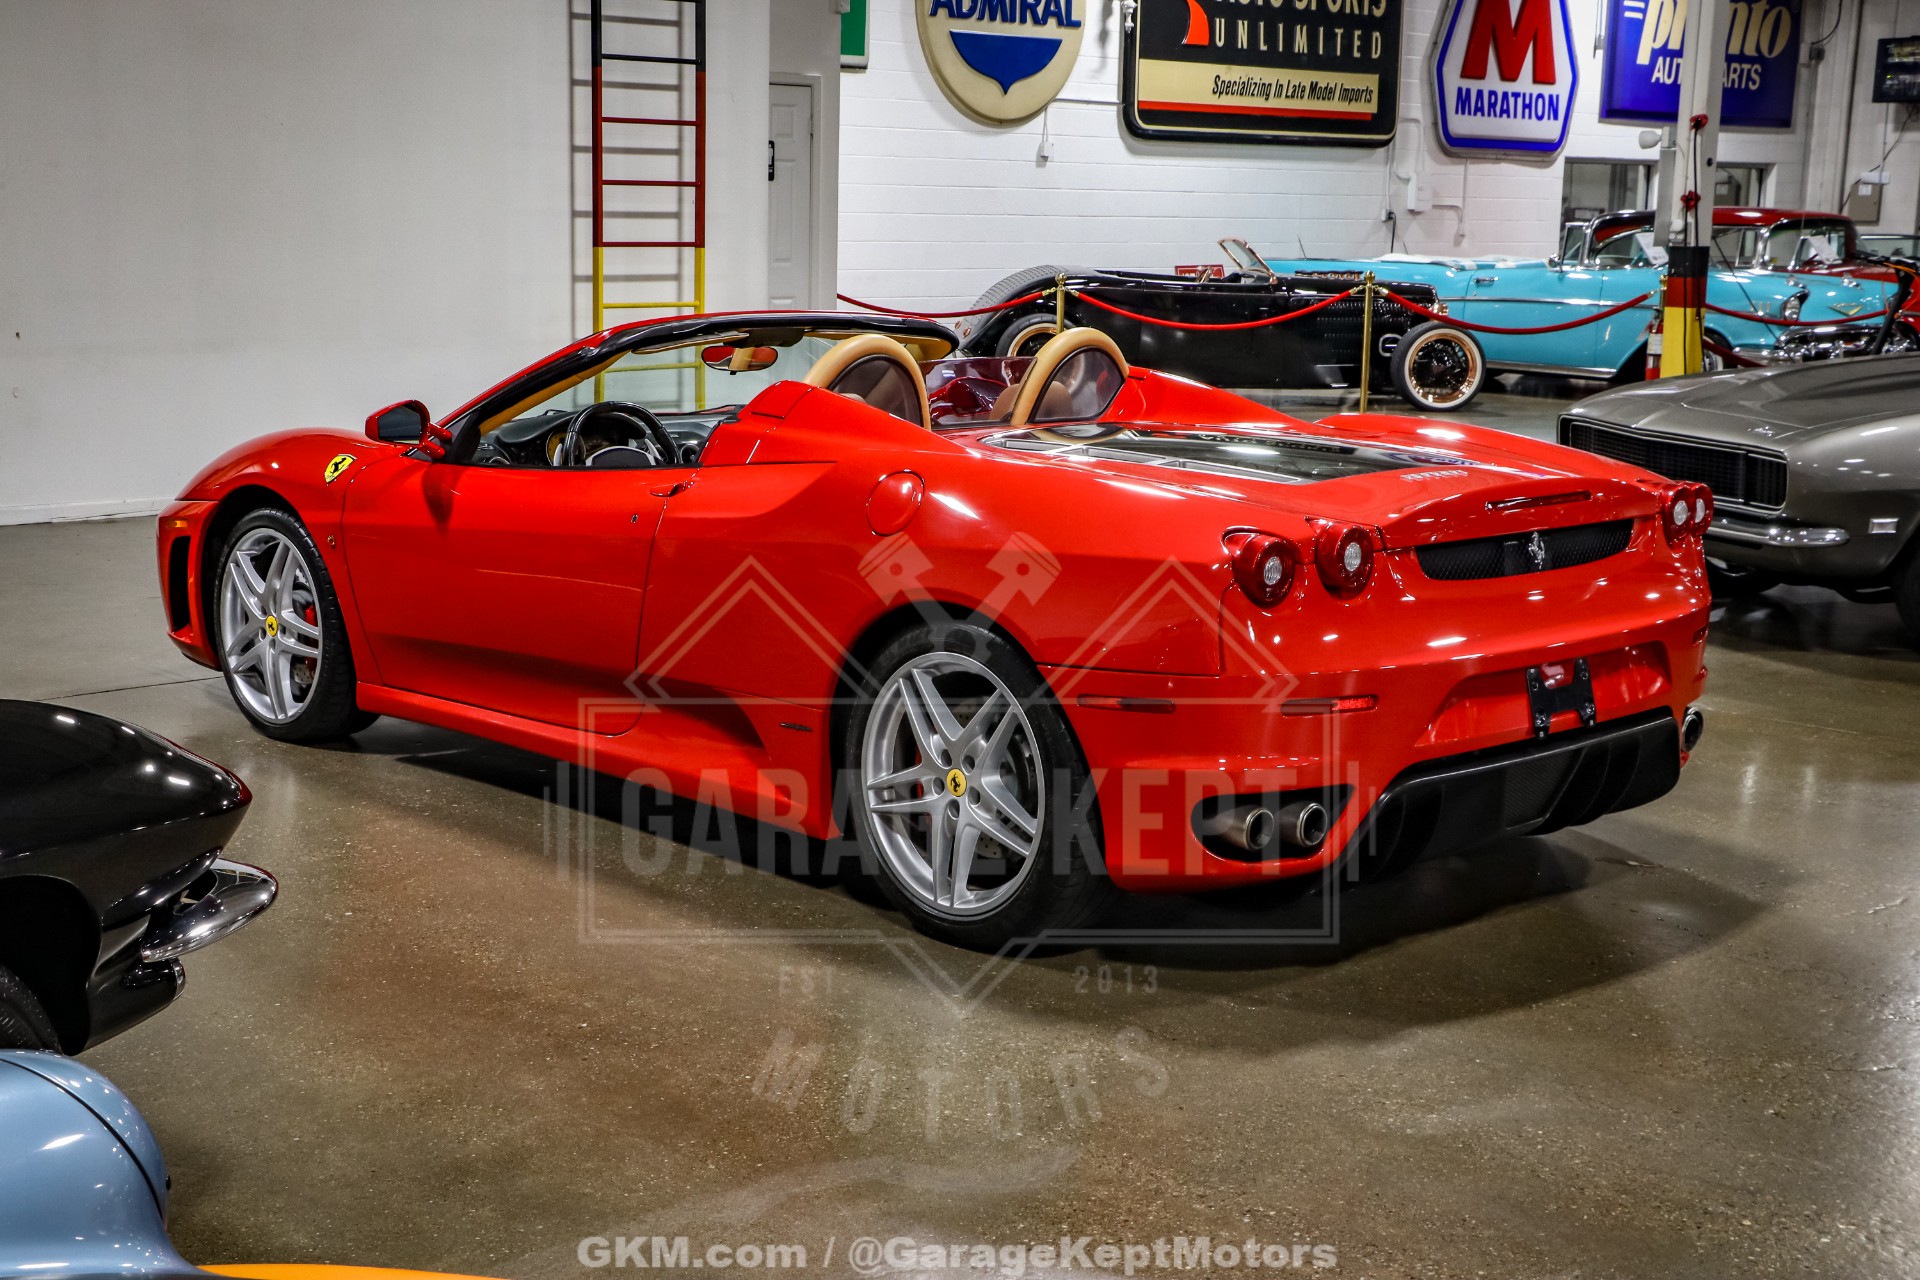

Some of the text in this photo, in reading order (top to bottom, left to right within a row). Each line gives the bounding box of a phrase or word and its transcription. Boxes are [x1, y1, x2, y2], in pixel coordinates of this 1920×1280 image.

[1215, 17, 1382, 59] UNLIMITED
[1651, 56, 1684, 85] AUT
[1212, 74, 1374, 105] Specializing In Late Model Imports
[1455, 86, 1560, 121] MARATHON
